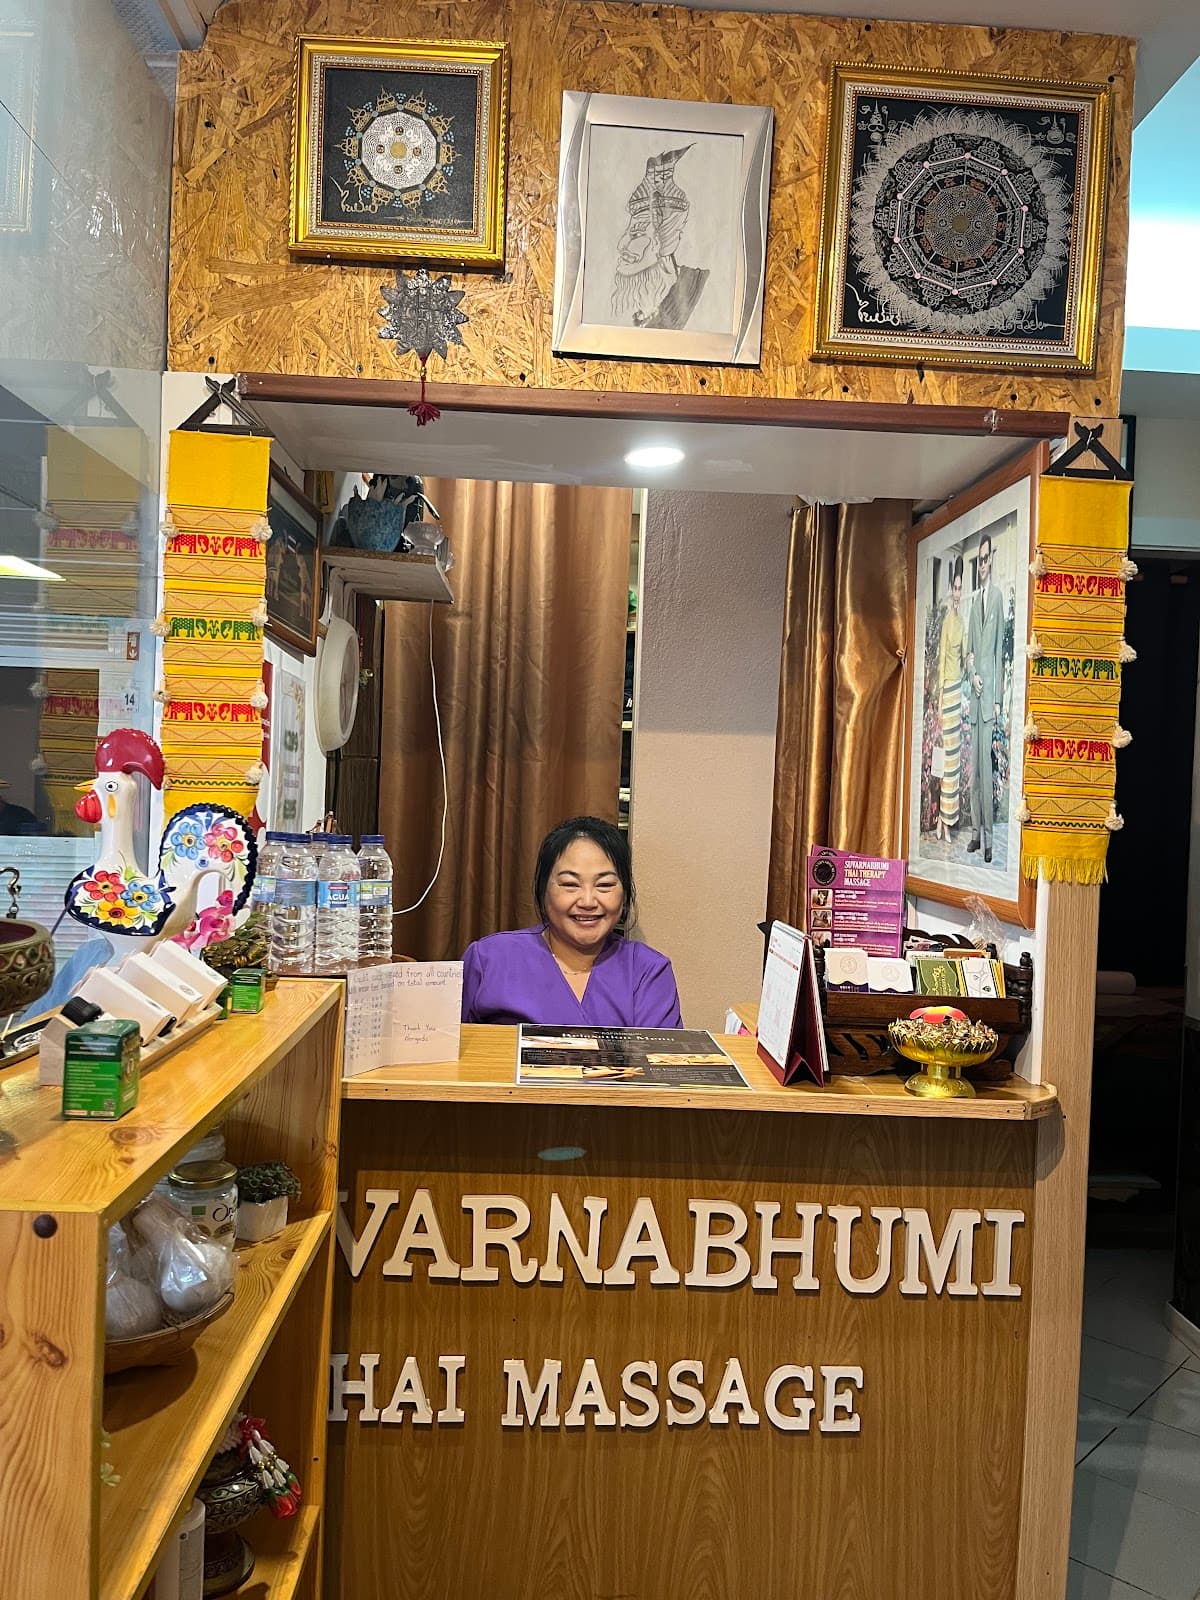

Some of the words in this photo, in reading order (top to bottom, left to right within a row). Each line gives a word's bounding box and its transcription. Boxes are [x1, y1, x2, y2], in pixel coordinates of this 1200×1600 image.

[124, 692, 135, 706] 14
[844, 869, 858, 878] THAI
[859, 870, 886, 879] THERAPY
[844, 877, 871, 887] MASSAGE
[501, 1357, 864, 1432] MASSAGE
